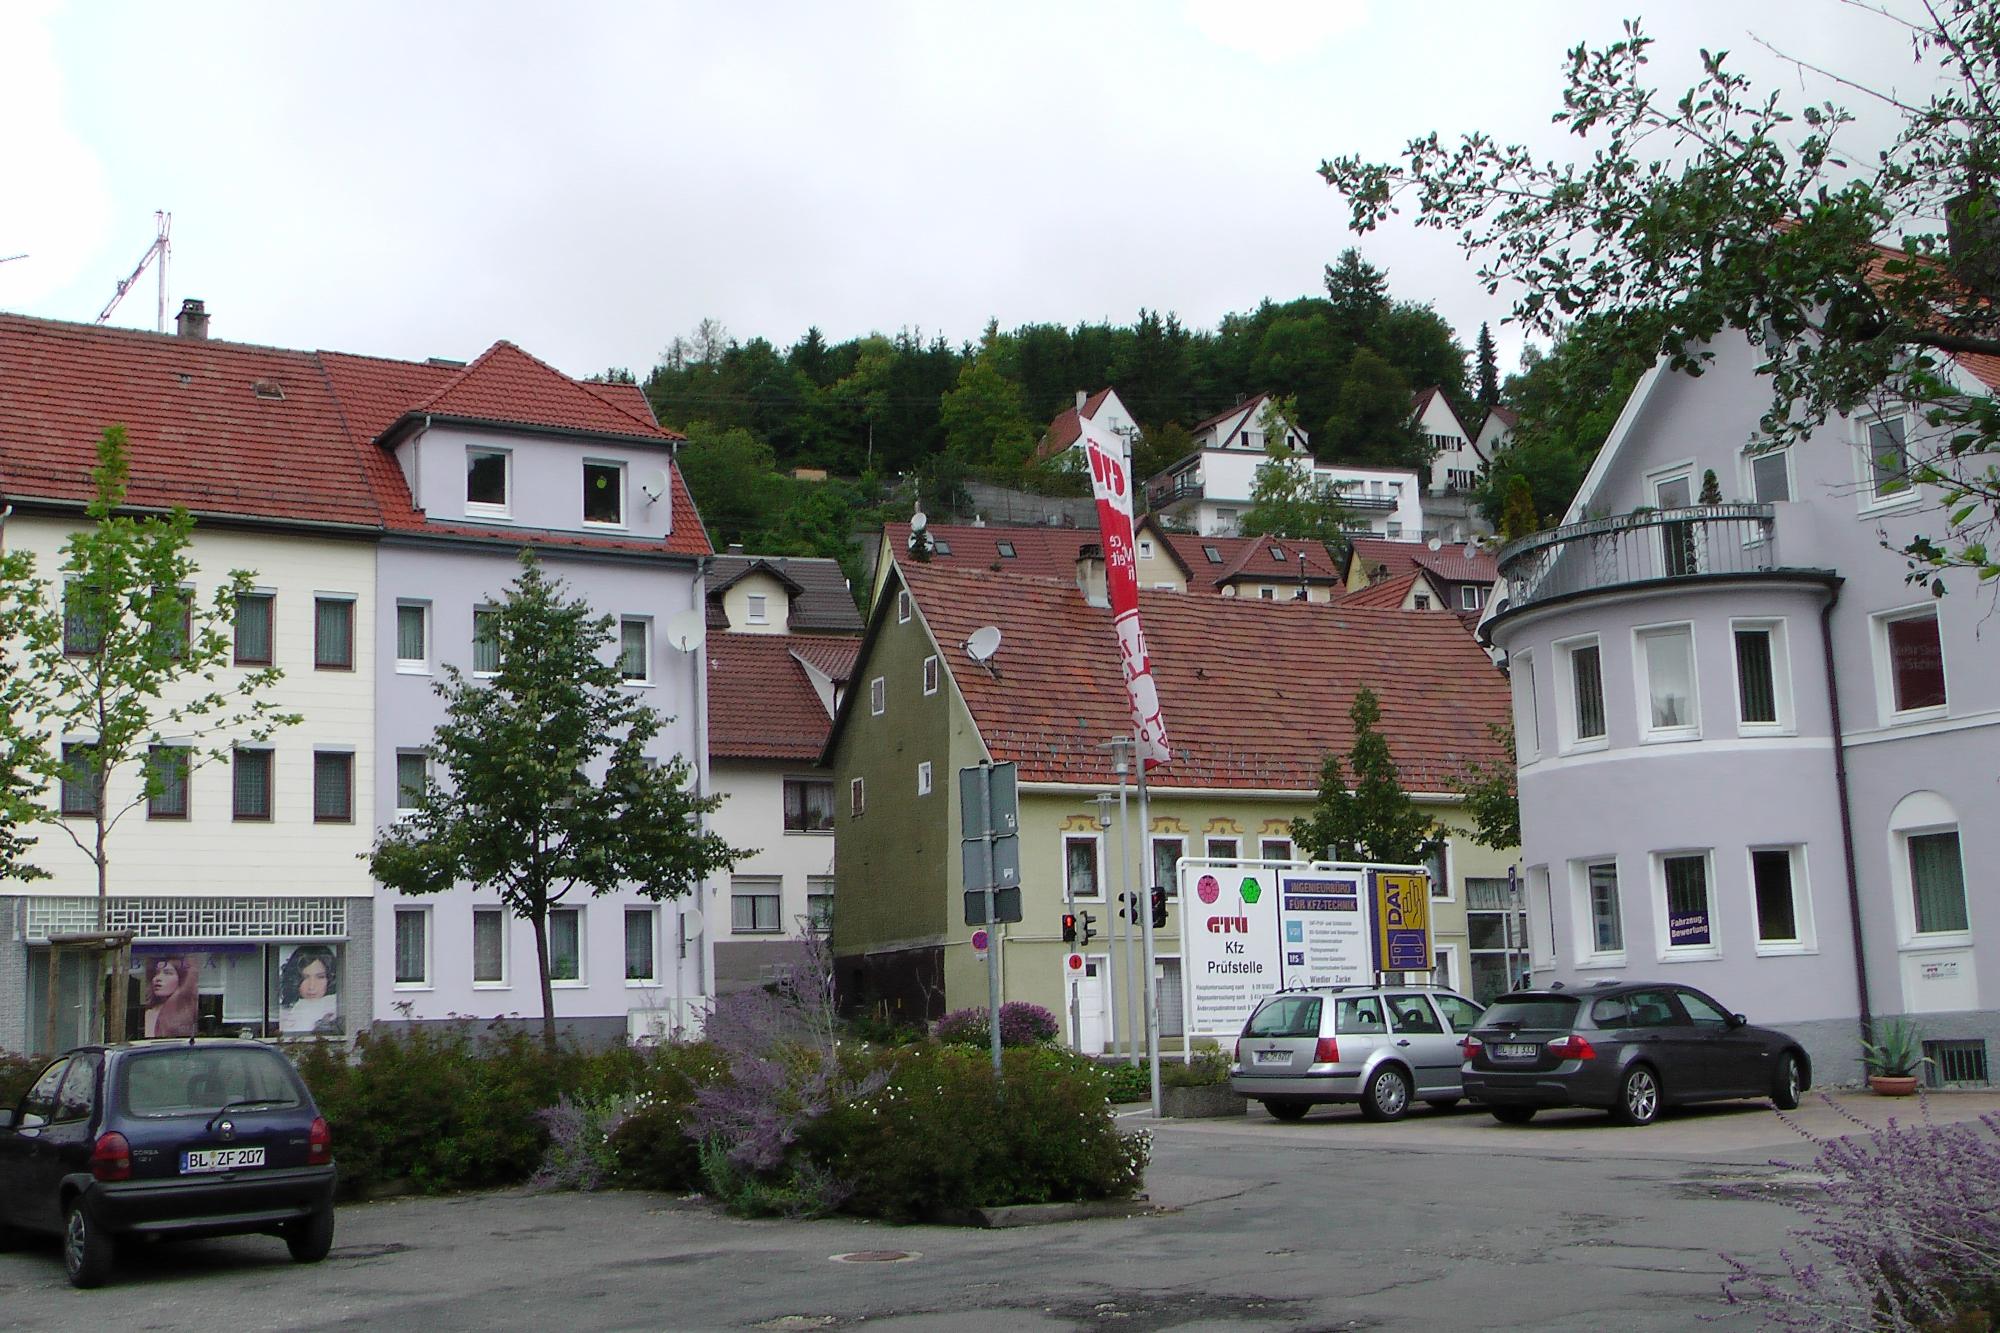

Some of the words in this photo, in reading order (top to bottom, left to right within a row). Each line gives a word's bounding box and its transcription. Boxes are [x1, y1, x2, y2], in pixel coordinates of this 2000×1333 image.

[1289, 898, 1306, 909] FÜR
[1307, 899, 1357, 911] KFZ-TECHNIK
[1387, 880, 1403, 926] DAT
[1670, 914, 1705, 928] Fahrzeug-
[1671, 924, 1709, 938] Bewertung
[1225, 940, 1245, 954] Kfz
[1207, 960, 1263, 974] Prüfstelle
[189, 1153, 208, 1168] BL
[217, 1151, 236, 1166] ZF
[238, 1149, 264, 1165] 207
